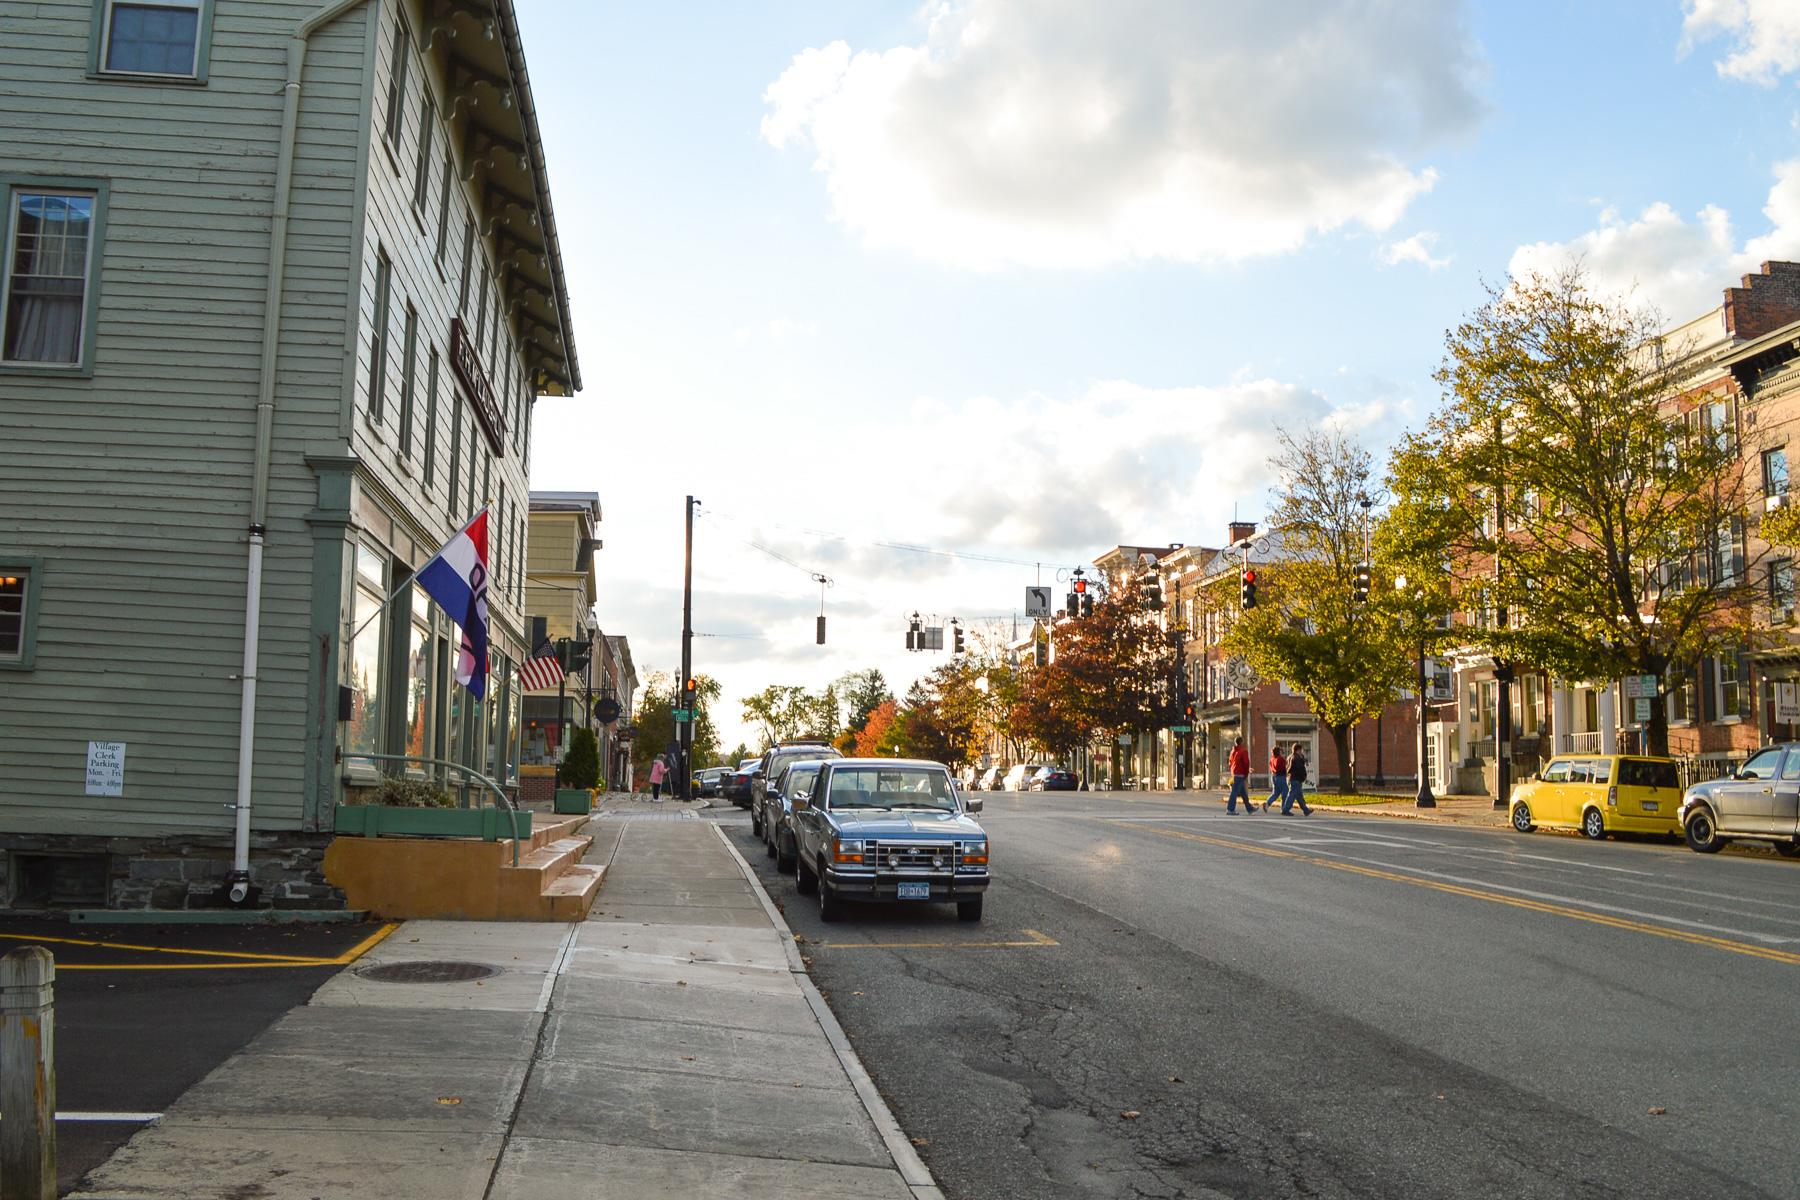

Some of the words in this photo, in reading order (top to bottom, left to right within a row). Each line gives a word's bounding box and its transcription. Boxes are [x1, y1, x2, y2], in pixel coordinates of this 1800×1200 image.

[1028, 608, 1048, 616] ONLY
[94, 742, 120, 751] Village
[95, 751, 116, 760] Clerk
[90, 759, 120, 769] Parking
[88, 768, 105, 776] Mon.
[111, 769, 122, 777] Fri.
